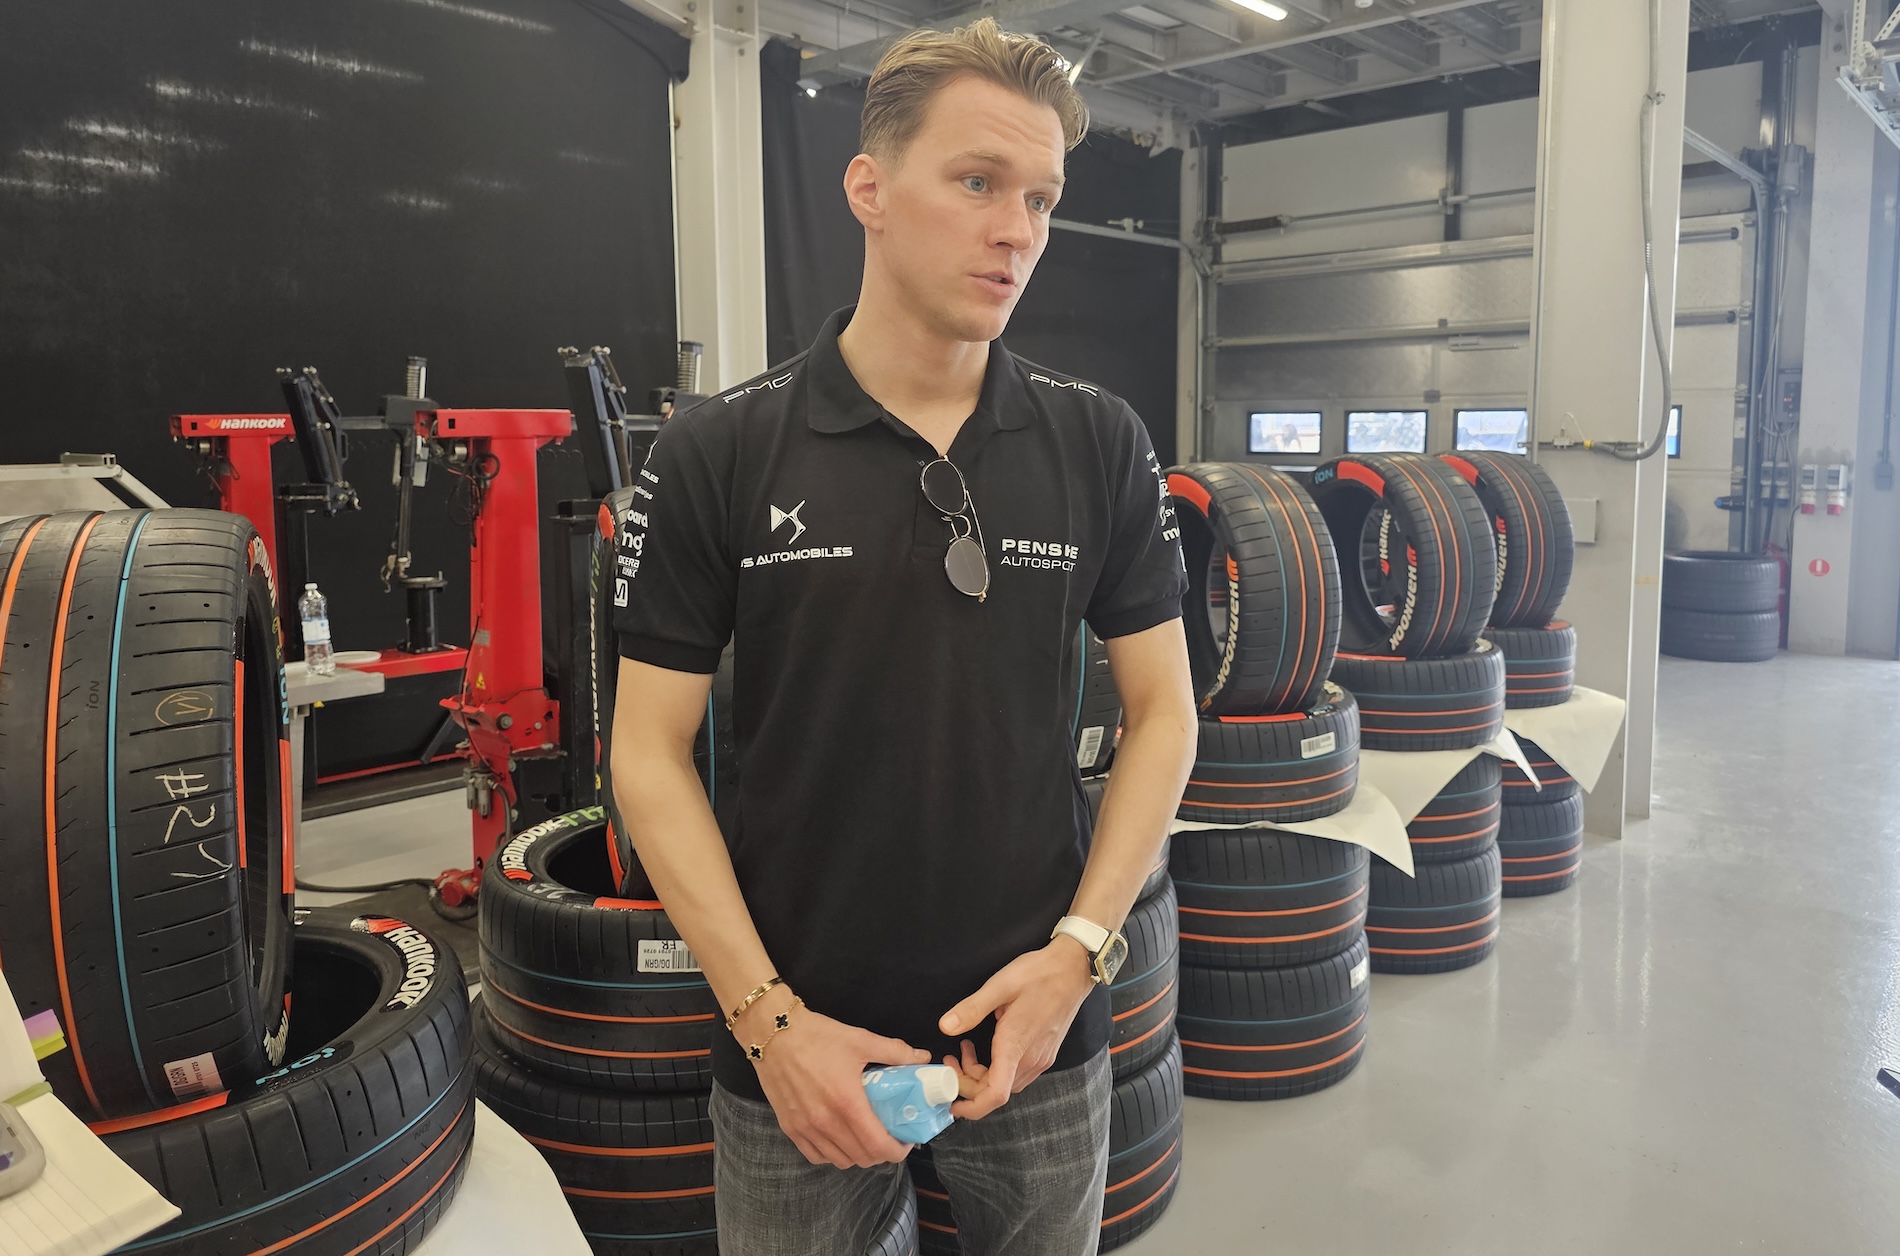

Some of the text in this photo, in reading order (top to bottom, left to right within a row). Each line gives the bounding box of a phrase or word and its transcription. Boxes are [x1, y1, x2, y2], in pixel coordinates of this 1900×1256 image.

[722, 372, 794, 404] PMC
[1030, 372, 1099, 397] PMC
[740, 546, 854, 568] S AUTOMOBILES
